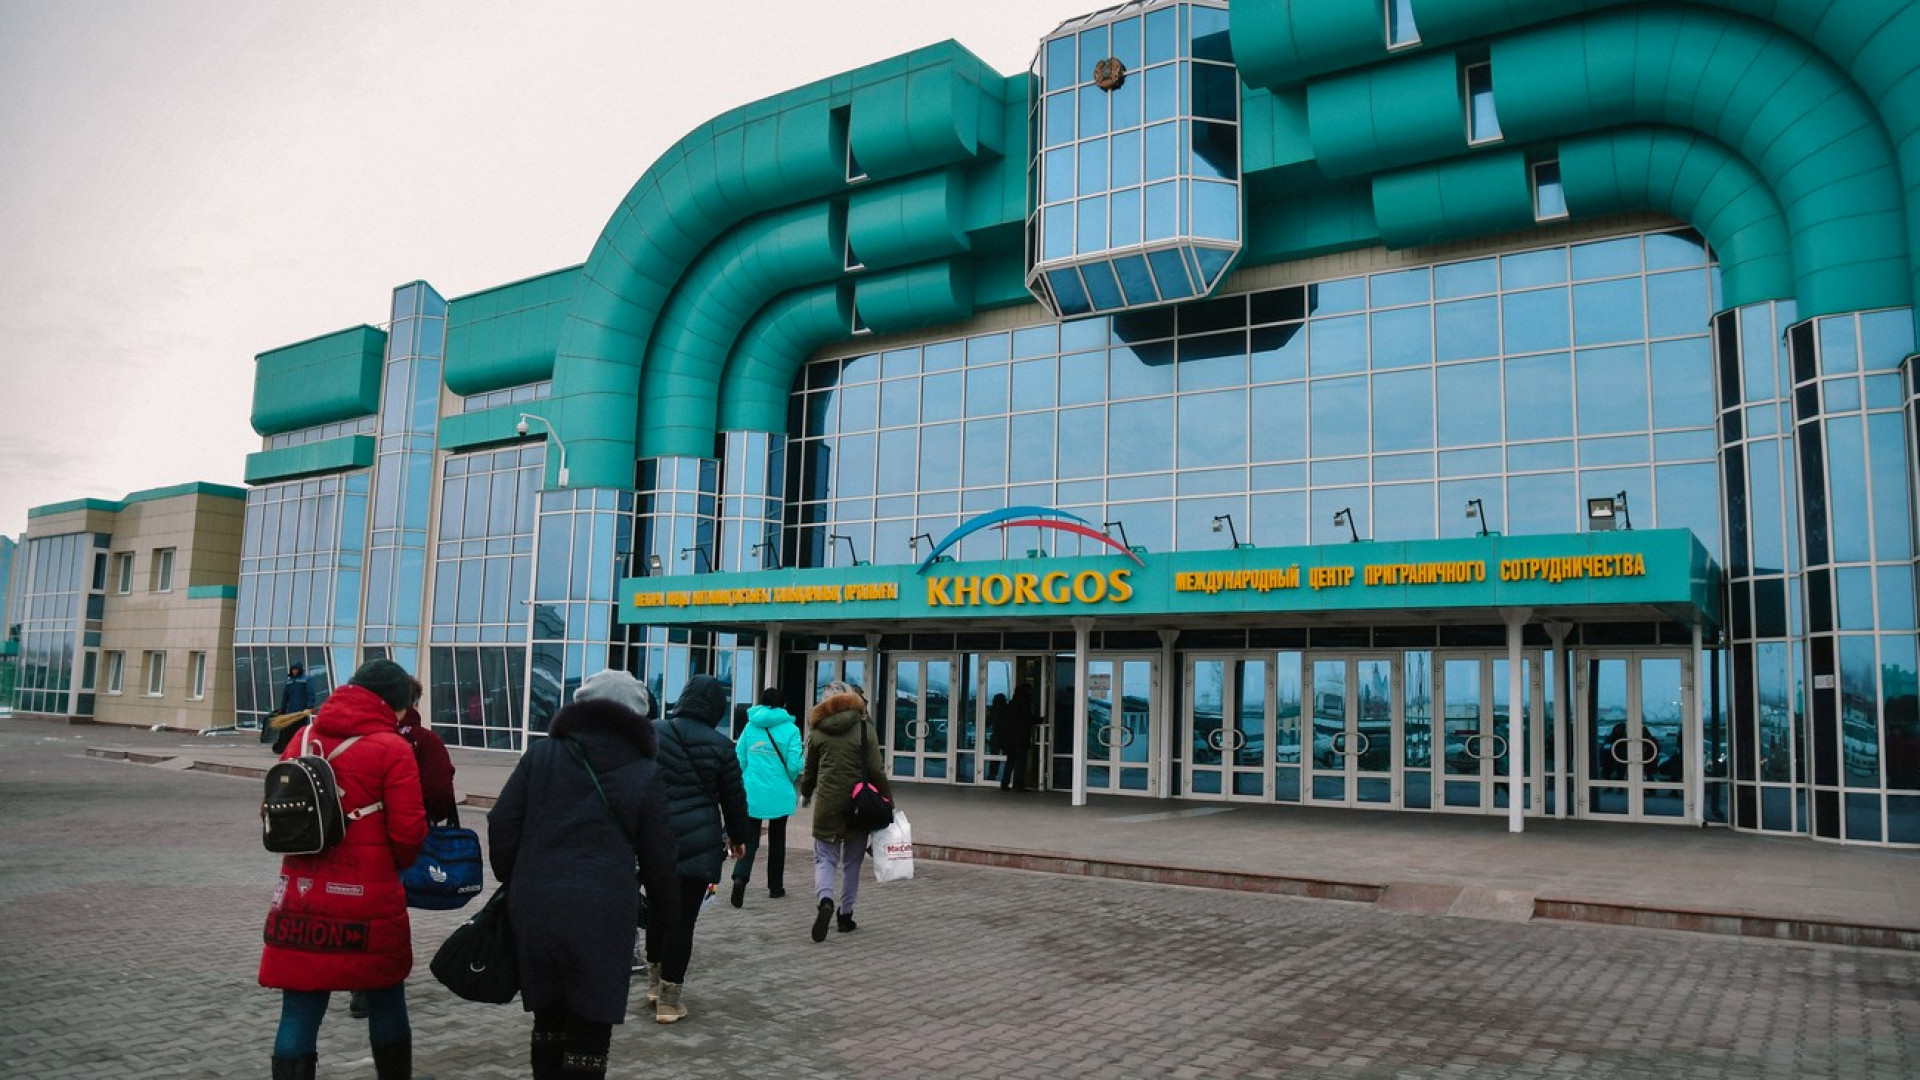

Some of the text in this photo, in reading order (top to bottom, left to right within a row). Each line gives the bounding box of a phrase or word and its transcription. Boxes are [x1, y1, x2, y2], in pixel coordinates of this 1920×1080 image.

[927, 568, 1134, 606] KHORGOS
[1175, 553, 1646, 594] МЕЖДУНАРОДНЫЙ ЦЕНТР ПРИГРАНИЧНОГО СОТРУДНИЧЕСТВА
